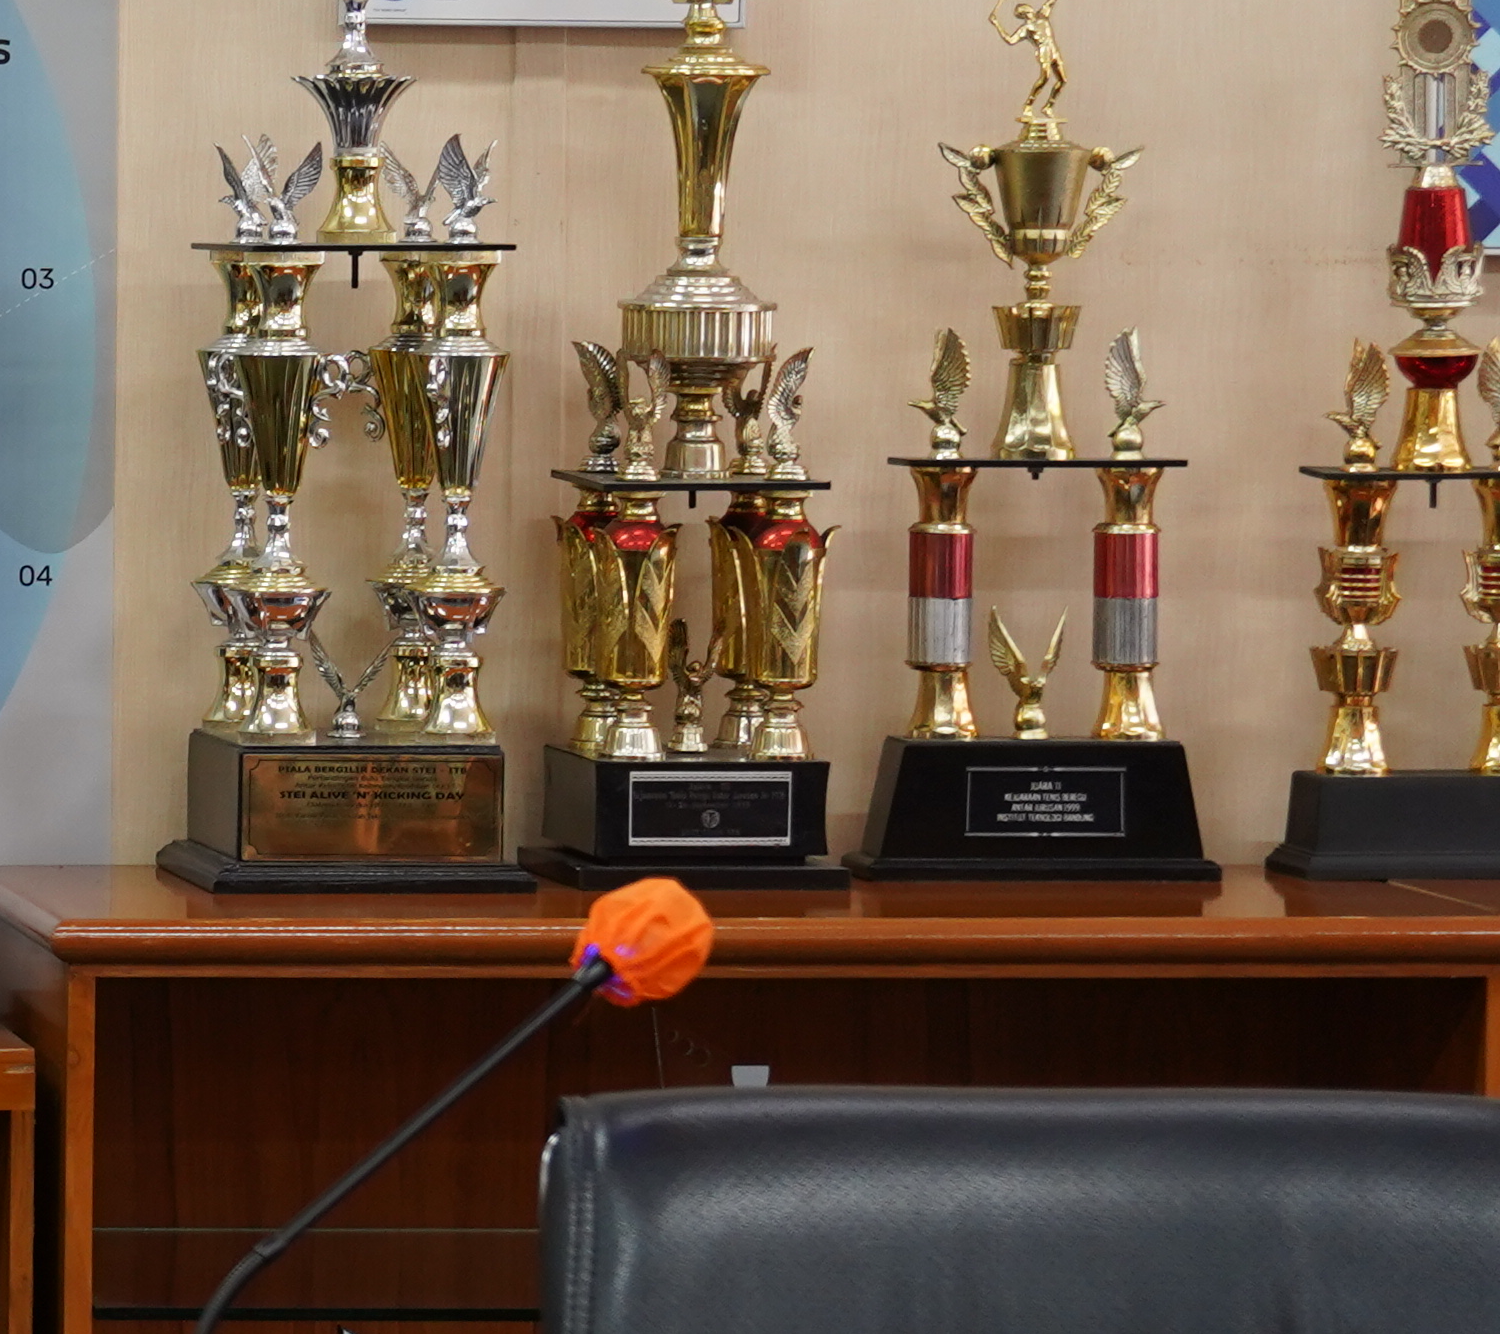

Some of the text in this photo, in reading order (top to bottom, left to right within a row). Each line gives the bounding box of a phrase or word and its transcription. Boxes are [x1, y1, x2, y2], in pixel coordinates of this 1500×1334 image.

[21, 267, 55, 290] 03
[18, 564, 53, 587] 04
[278, 790, 306, 801] STEI
[309, 790, 348, 801] ALIVE
[373, 790, 432, 801] KICKING
[435, 790, 465, 802] DAY
